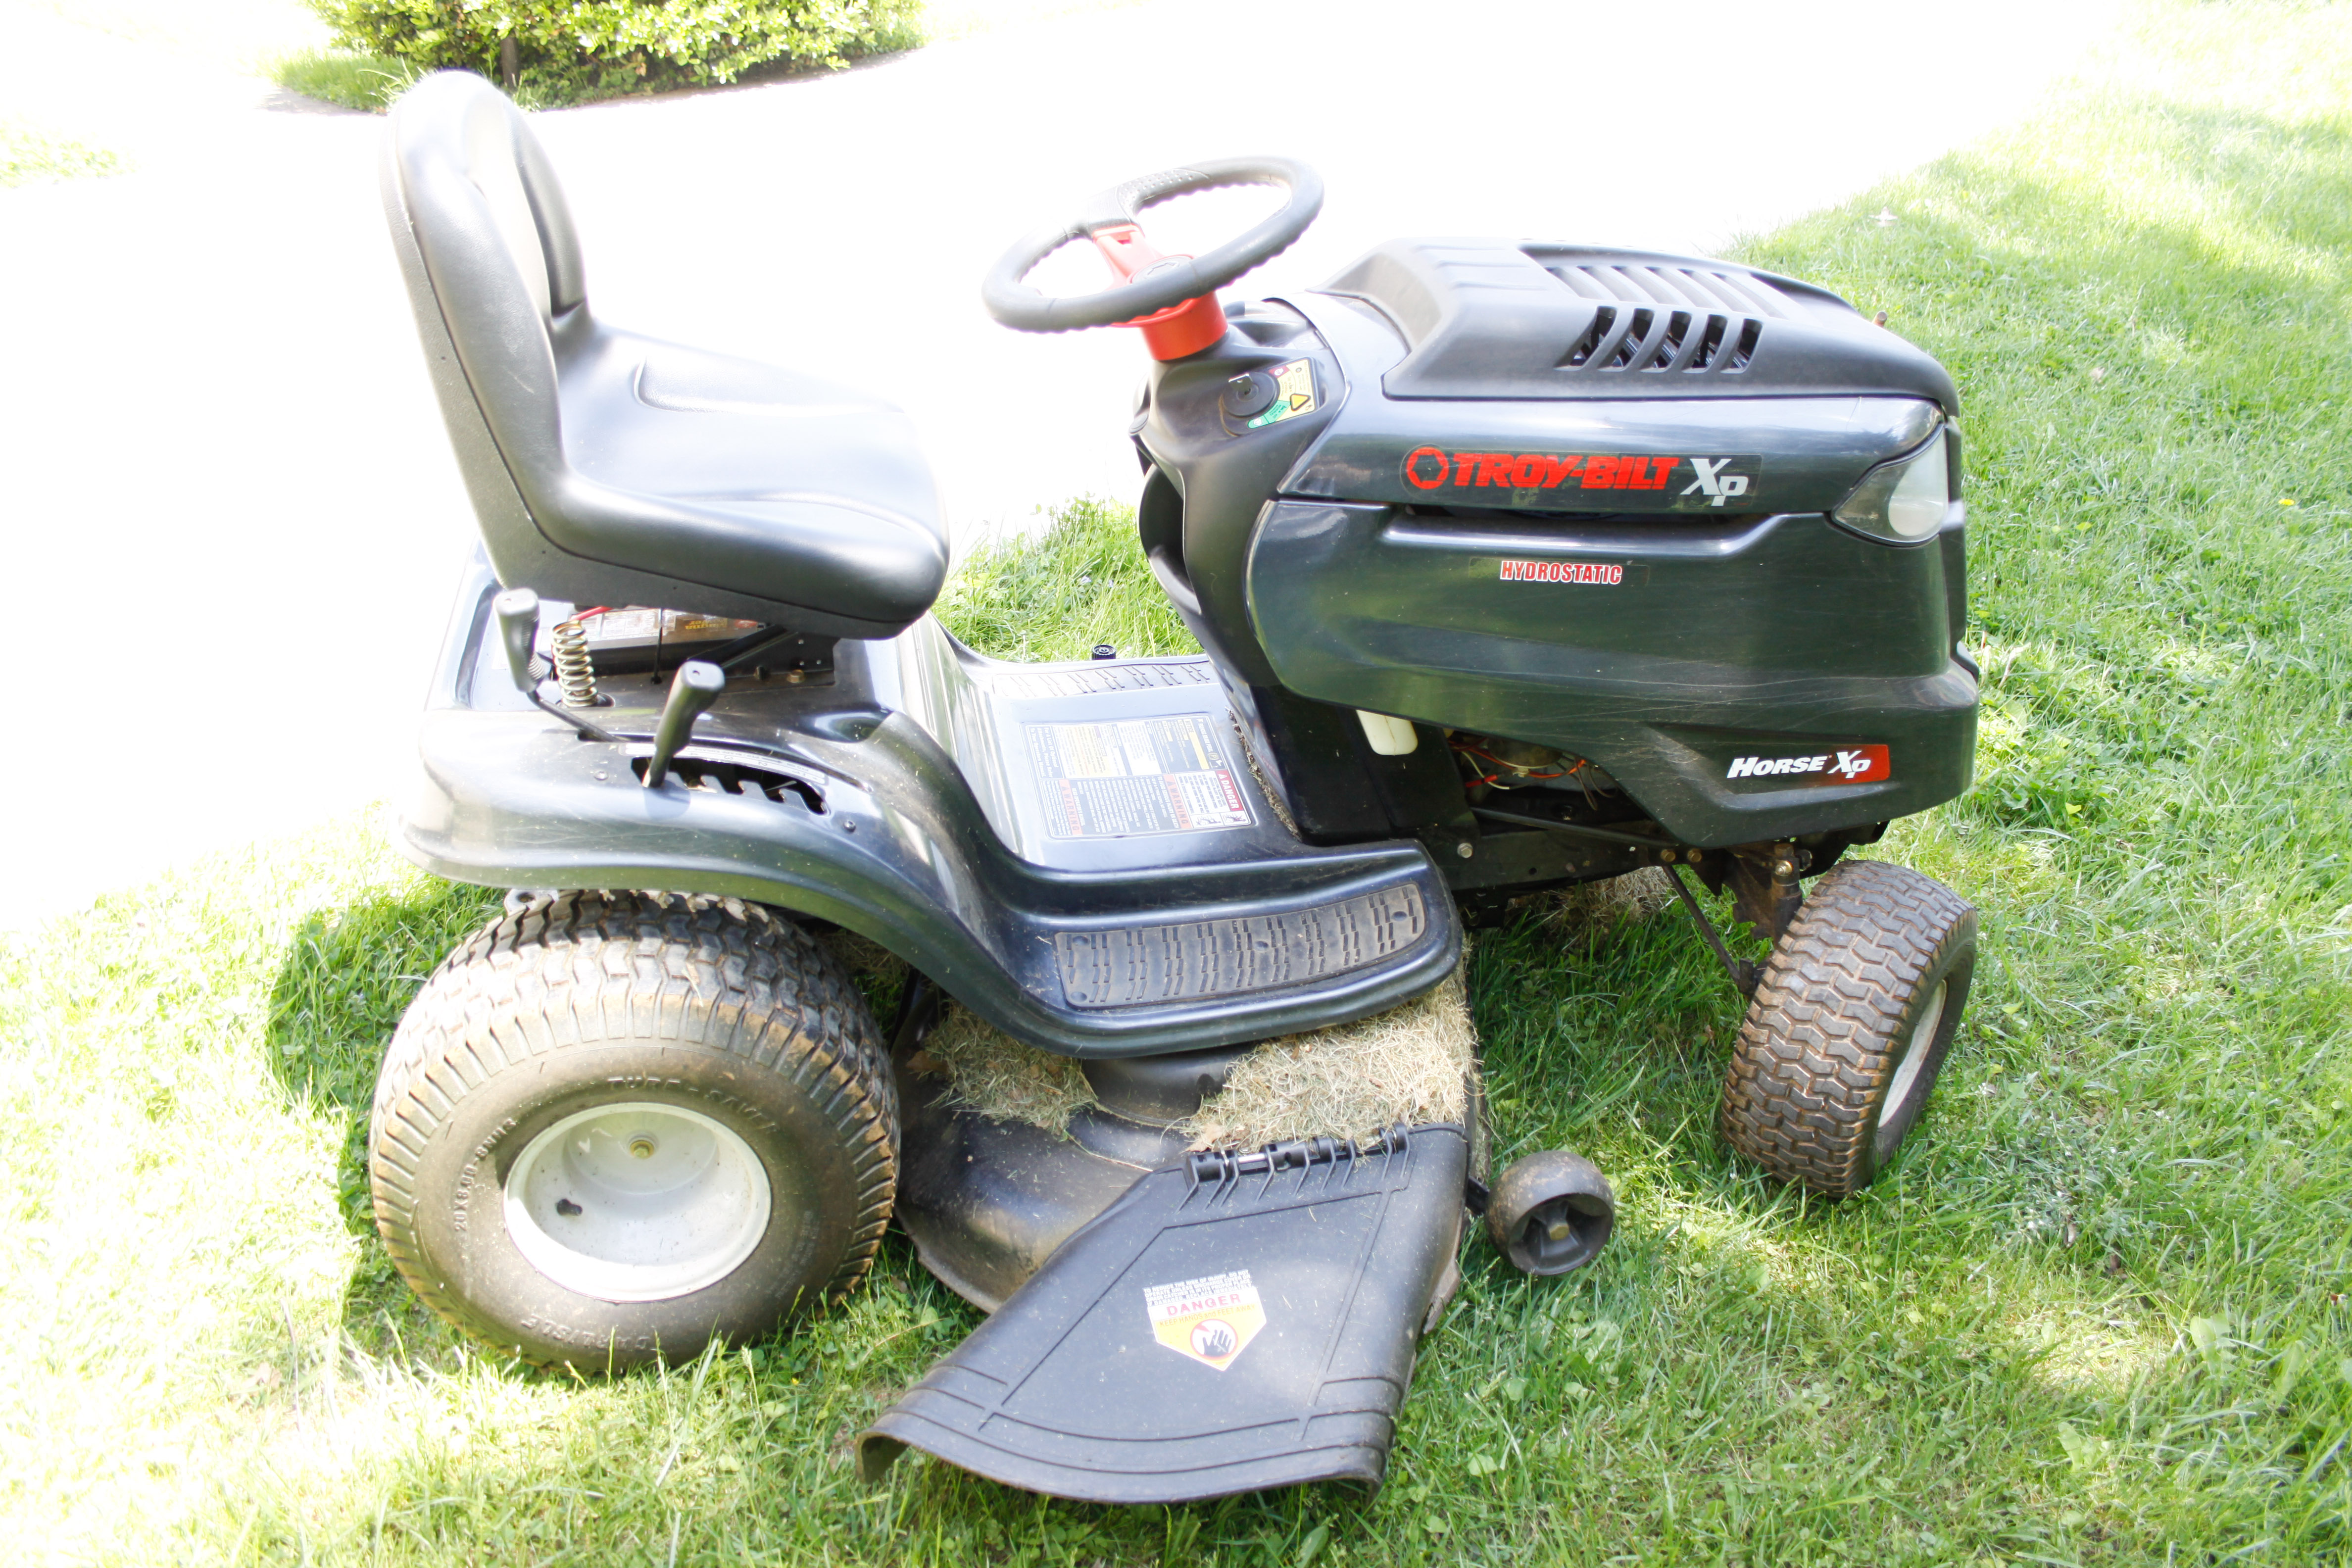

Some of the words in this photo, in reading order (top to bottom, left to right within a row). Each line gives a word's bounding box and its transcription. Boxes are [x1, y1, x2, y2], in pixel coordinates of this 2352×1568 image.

[1454, 452, 1679, 490] TROY-BILT
[1500, 561, 1622, 585] HYDROSTATIC
[1726, 757, 1828, 779] HORSE
[1169, 788, 1189, 824] WARNING
[1221, 780, 1240, 808] DANGER
[1063, 793, 1080, 831] WARNING
[1160, 1318, 1178, 1327] KEEP
[1179, 1313, 1203, 1323] HANDS
[1217, 1308, 1234, 1317] FEET
[1236, 1304, 1256, 1312] AWAY
[1166, 1293, 1241, 1317] DANGER
